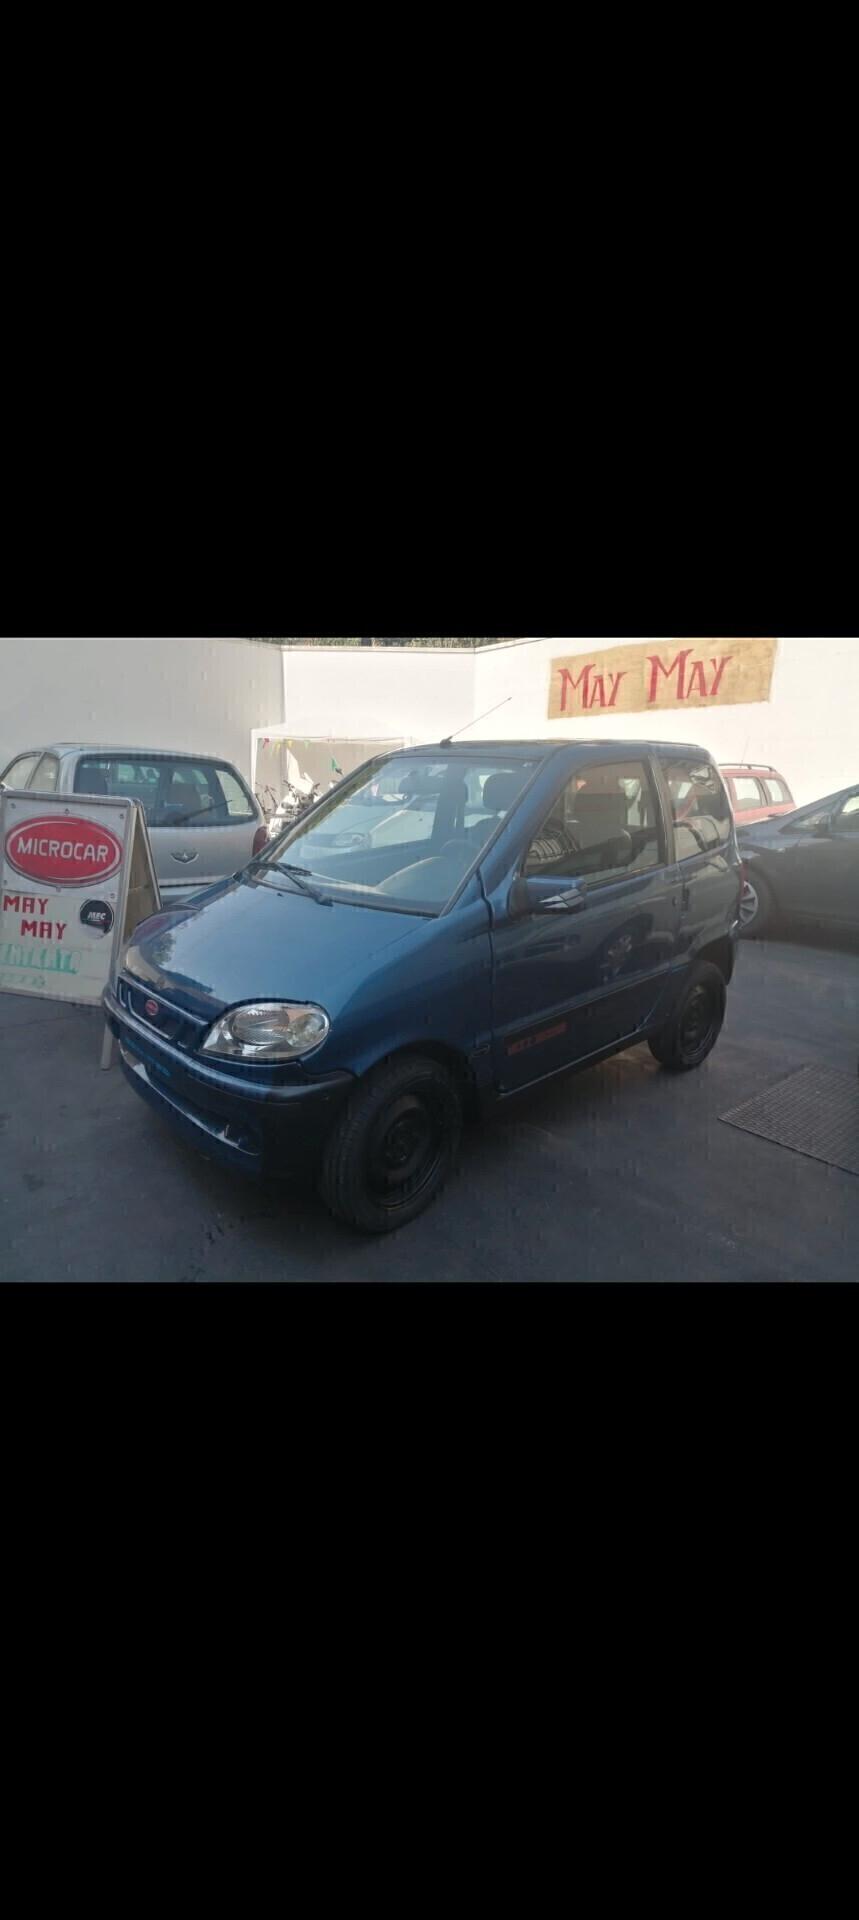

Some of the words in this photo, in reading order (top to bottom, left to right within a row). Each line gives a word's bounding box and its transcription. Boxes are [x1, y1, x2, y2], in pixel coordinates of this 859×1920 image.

[558, 664, 627, 711] MAY
[646, 649, 733, 703] MAY
[17, 837, 109, 863] MICROCAR
[3, 895, 49, 915] MAY
[21, 919, 67, 940] MAY
